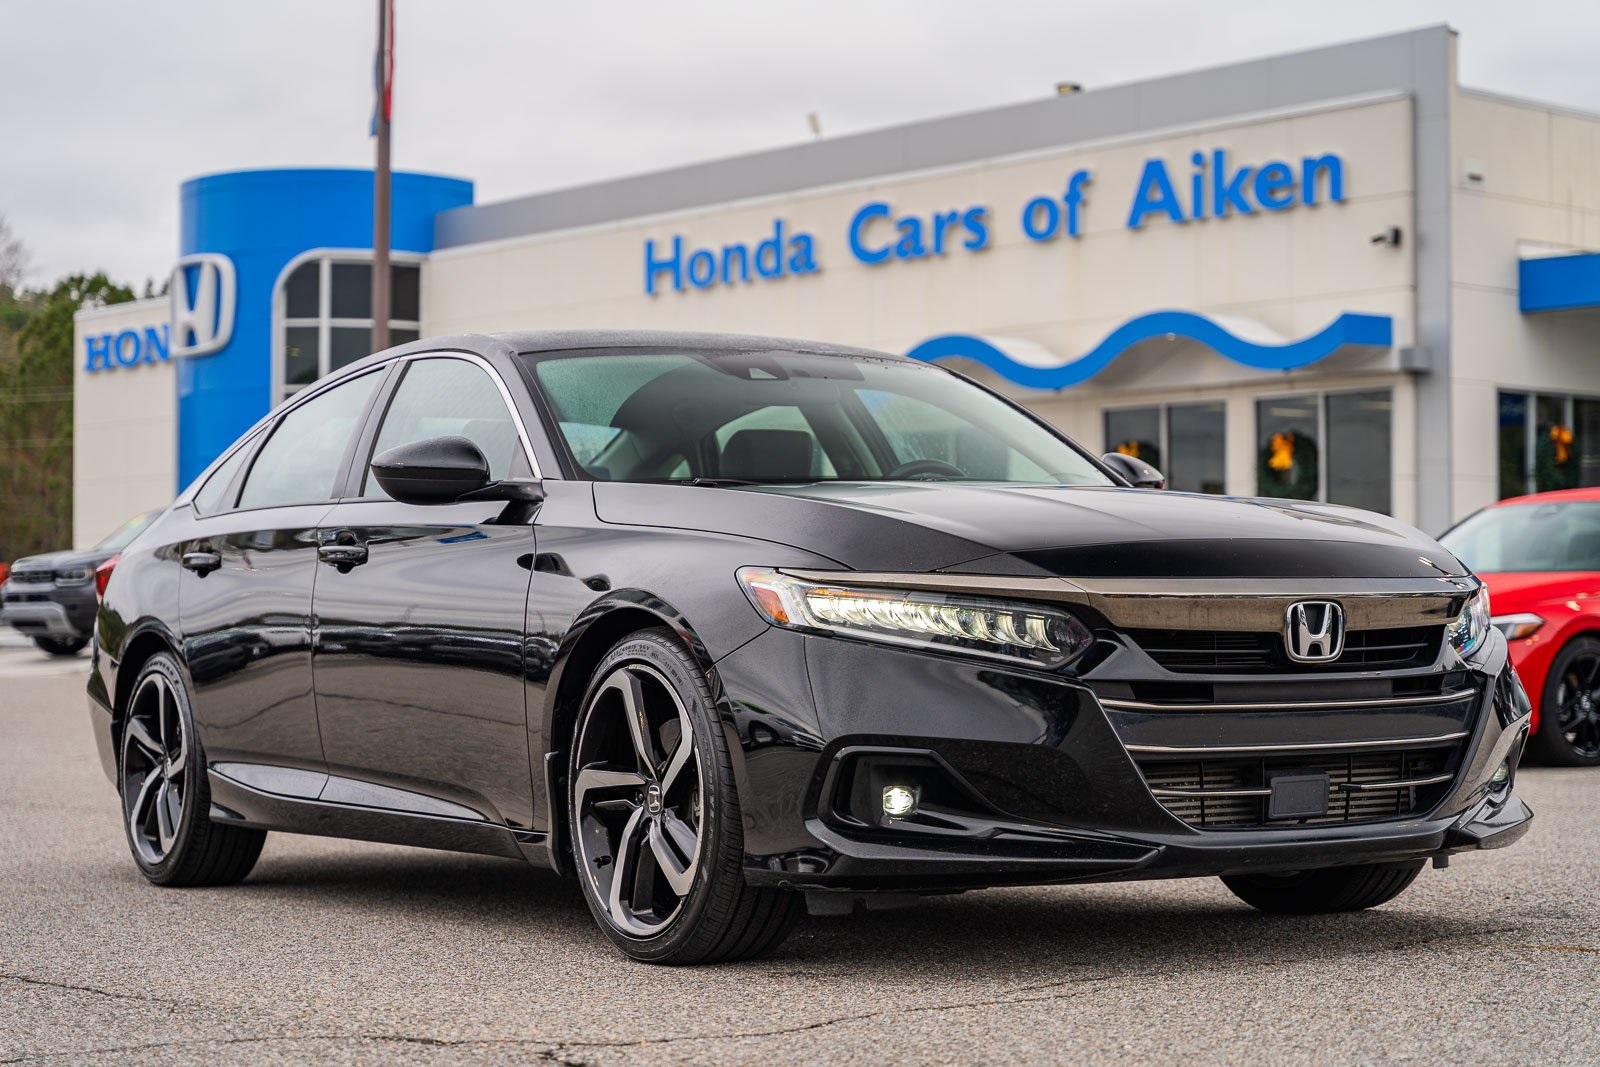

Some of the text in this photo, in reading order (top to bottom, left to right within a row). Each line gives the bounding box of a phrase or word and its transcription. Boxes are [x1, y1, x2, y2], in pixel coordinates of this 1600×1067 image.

[644, 147, 1345, 295] Honda Cars of Aiken
